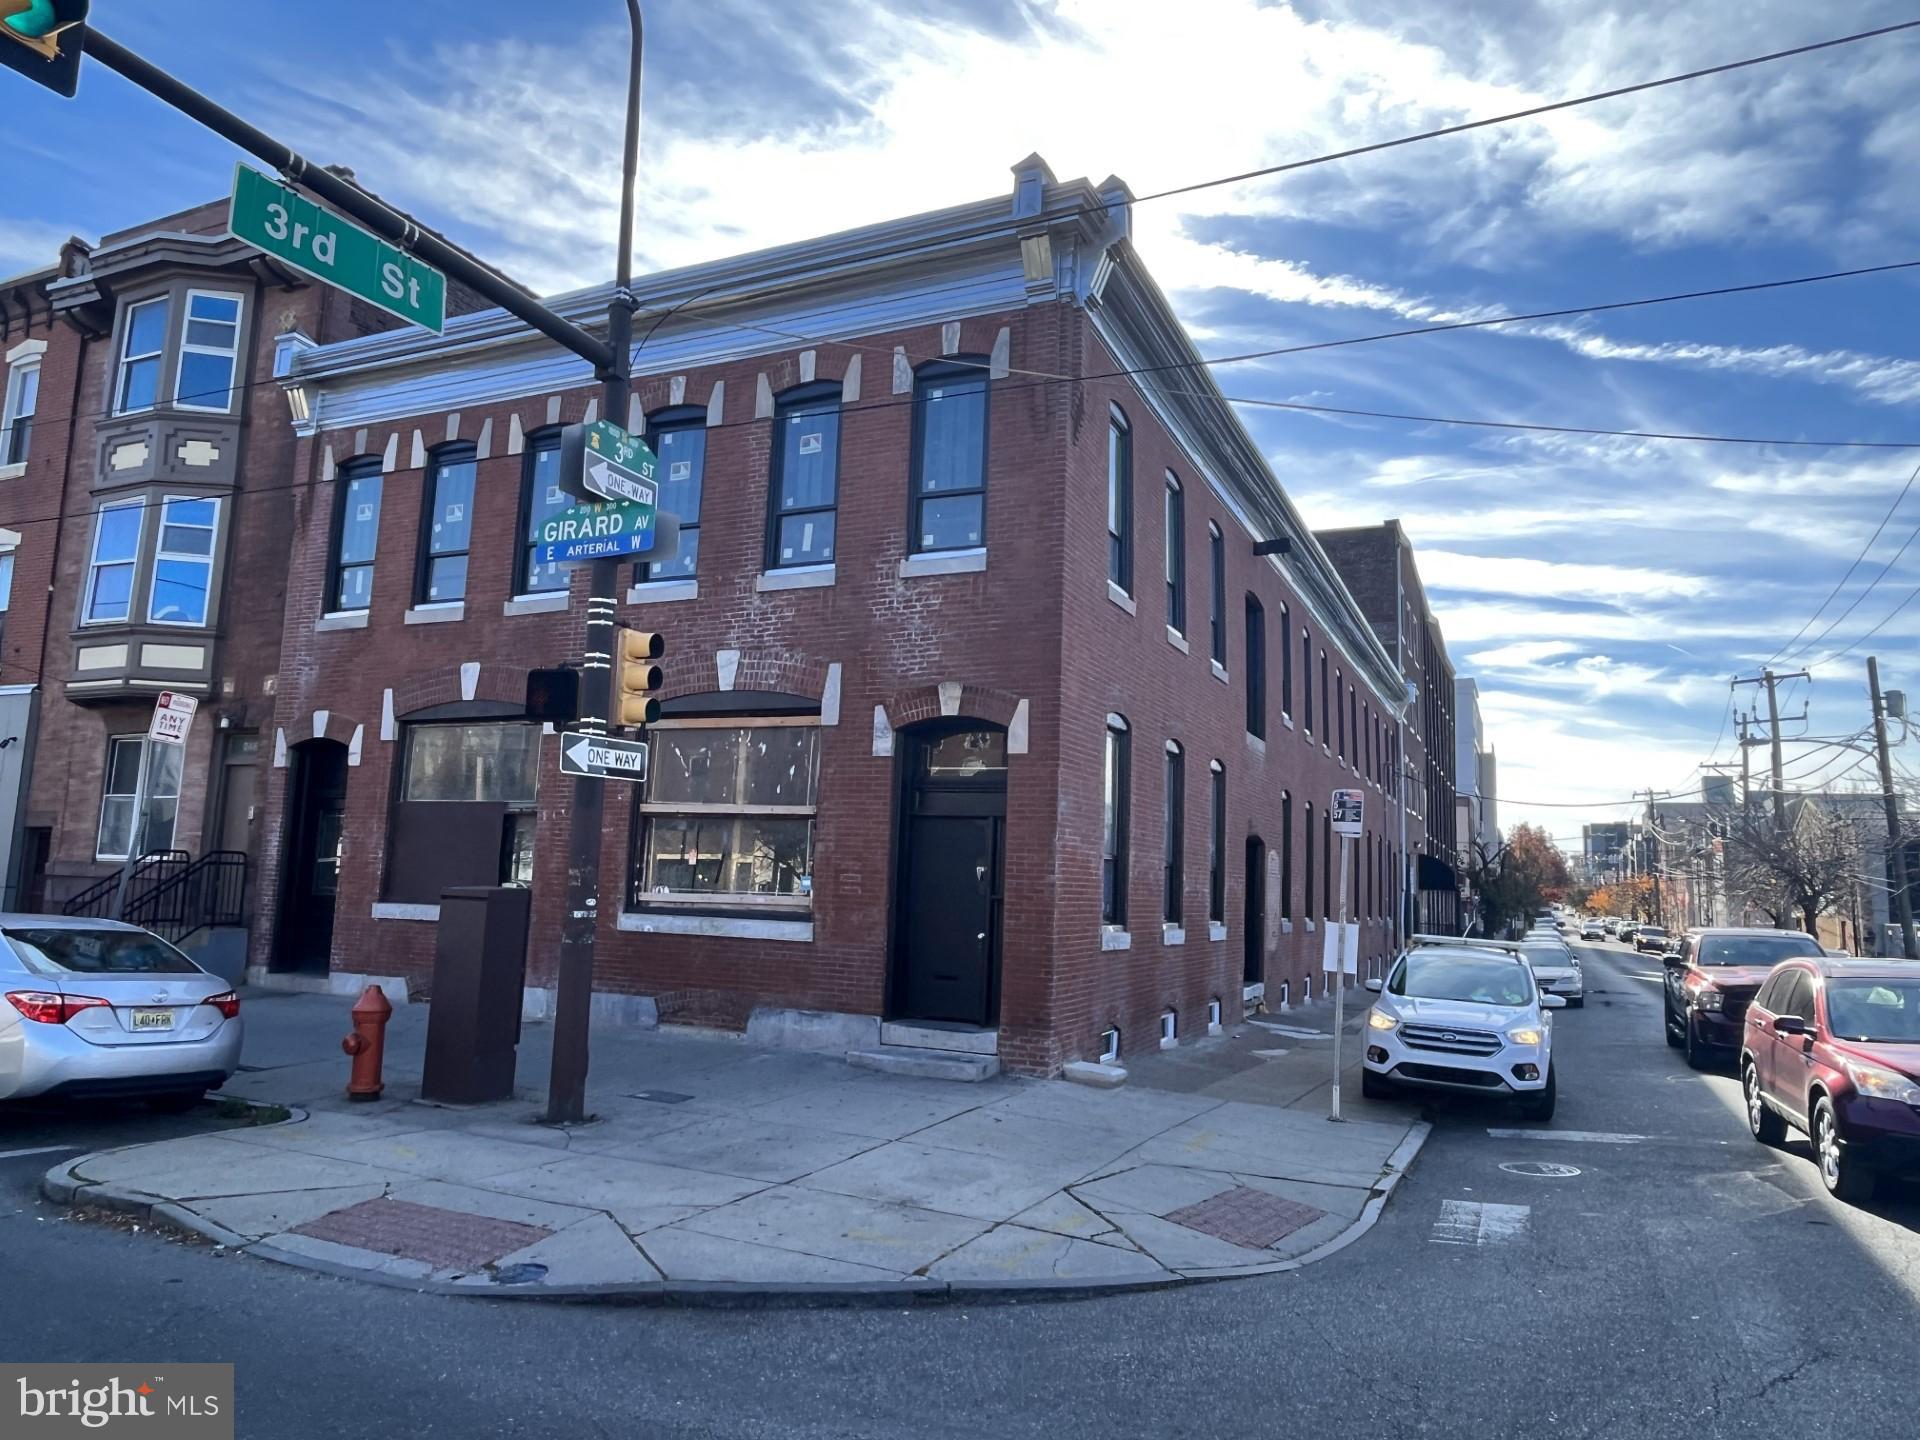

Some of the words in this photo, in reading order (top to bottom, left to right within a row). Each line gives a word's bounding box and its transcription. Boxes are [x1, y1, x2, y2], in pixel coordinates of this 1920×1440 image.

[264, 203, 337, 266] 3rd
[381, 262, 420, 309] St
[642, 462, 655, 478] ST
[607, 474, 627, 494] ONE
[631, 484, 651, 503] WAY
[544, 513, 623, 542] GIRARD
[634, 515, 649, 530] AV
[546, 546, 555, 560] E
[566, 541, 620, 557] ARTERIAL
[631, 535, 641, 550] W
[160, 713, 186, 724] ANY
[160, 721, 183, 733] TIME
[588, 748, 610, 765] ONE
[615, 751, 638, 768] WAY
